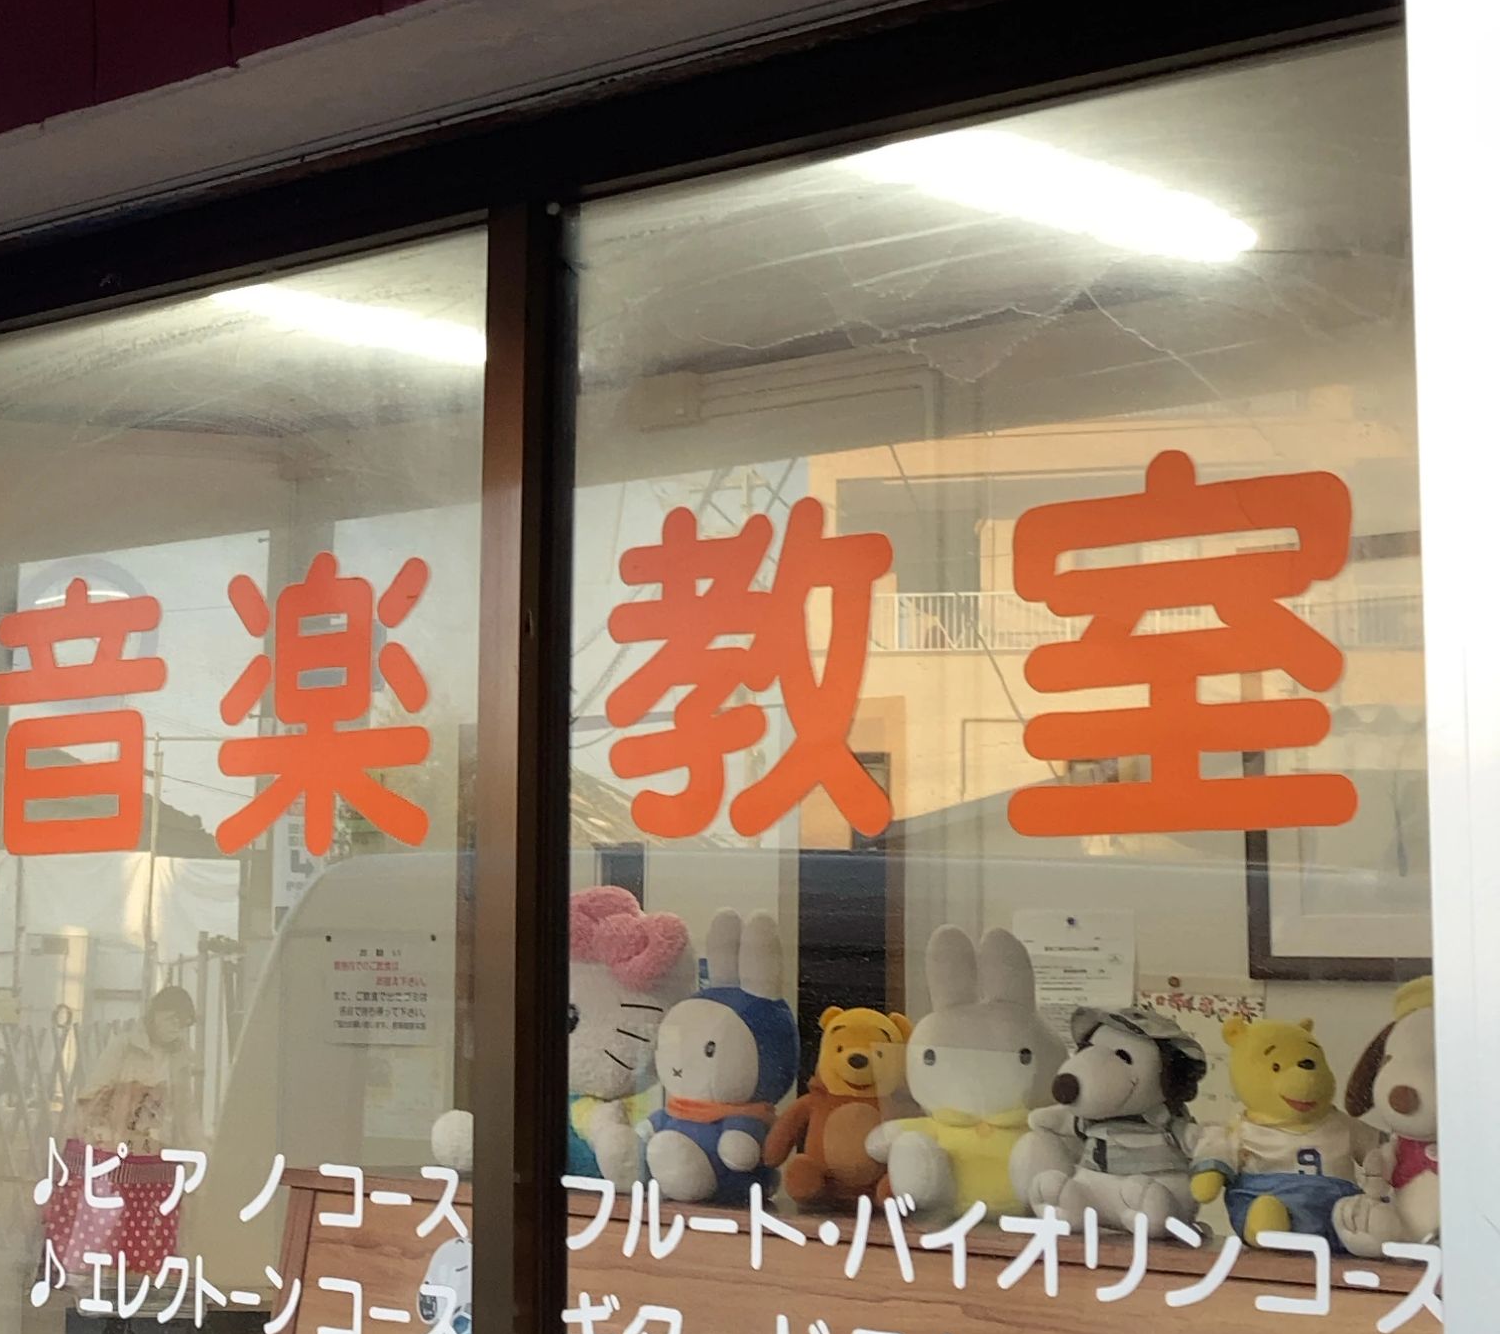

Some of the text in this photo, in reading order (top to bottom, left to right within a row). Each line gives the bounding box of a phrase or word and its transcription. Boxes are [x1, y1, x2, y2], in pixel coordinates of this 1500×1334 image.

[560, 1175, 1445, 1334] フルート・バイオリンコース
